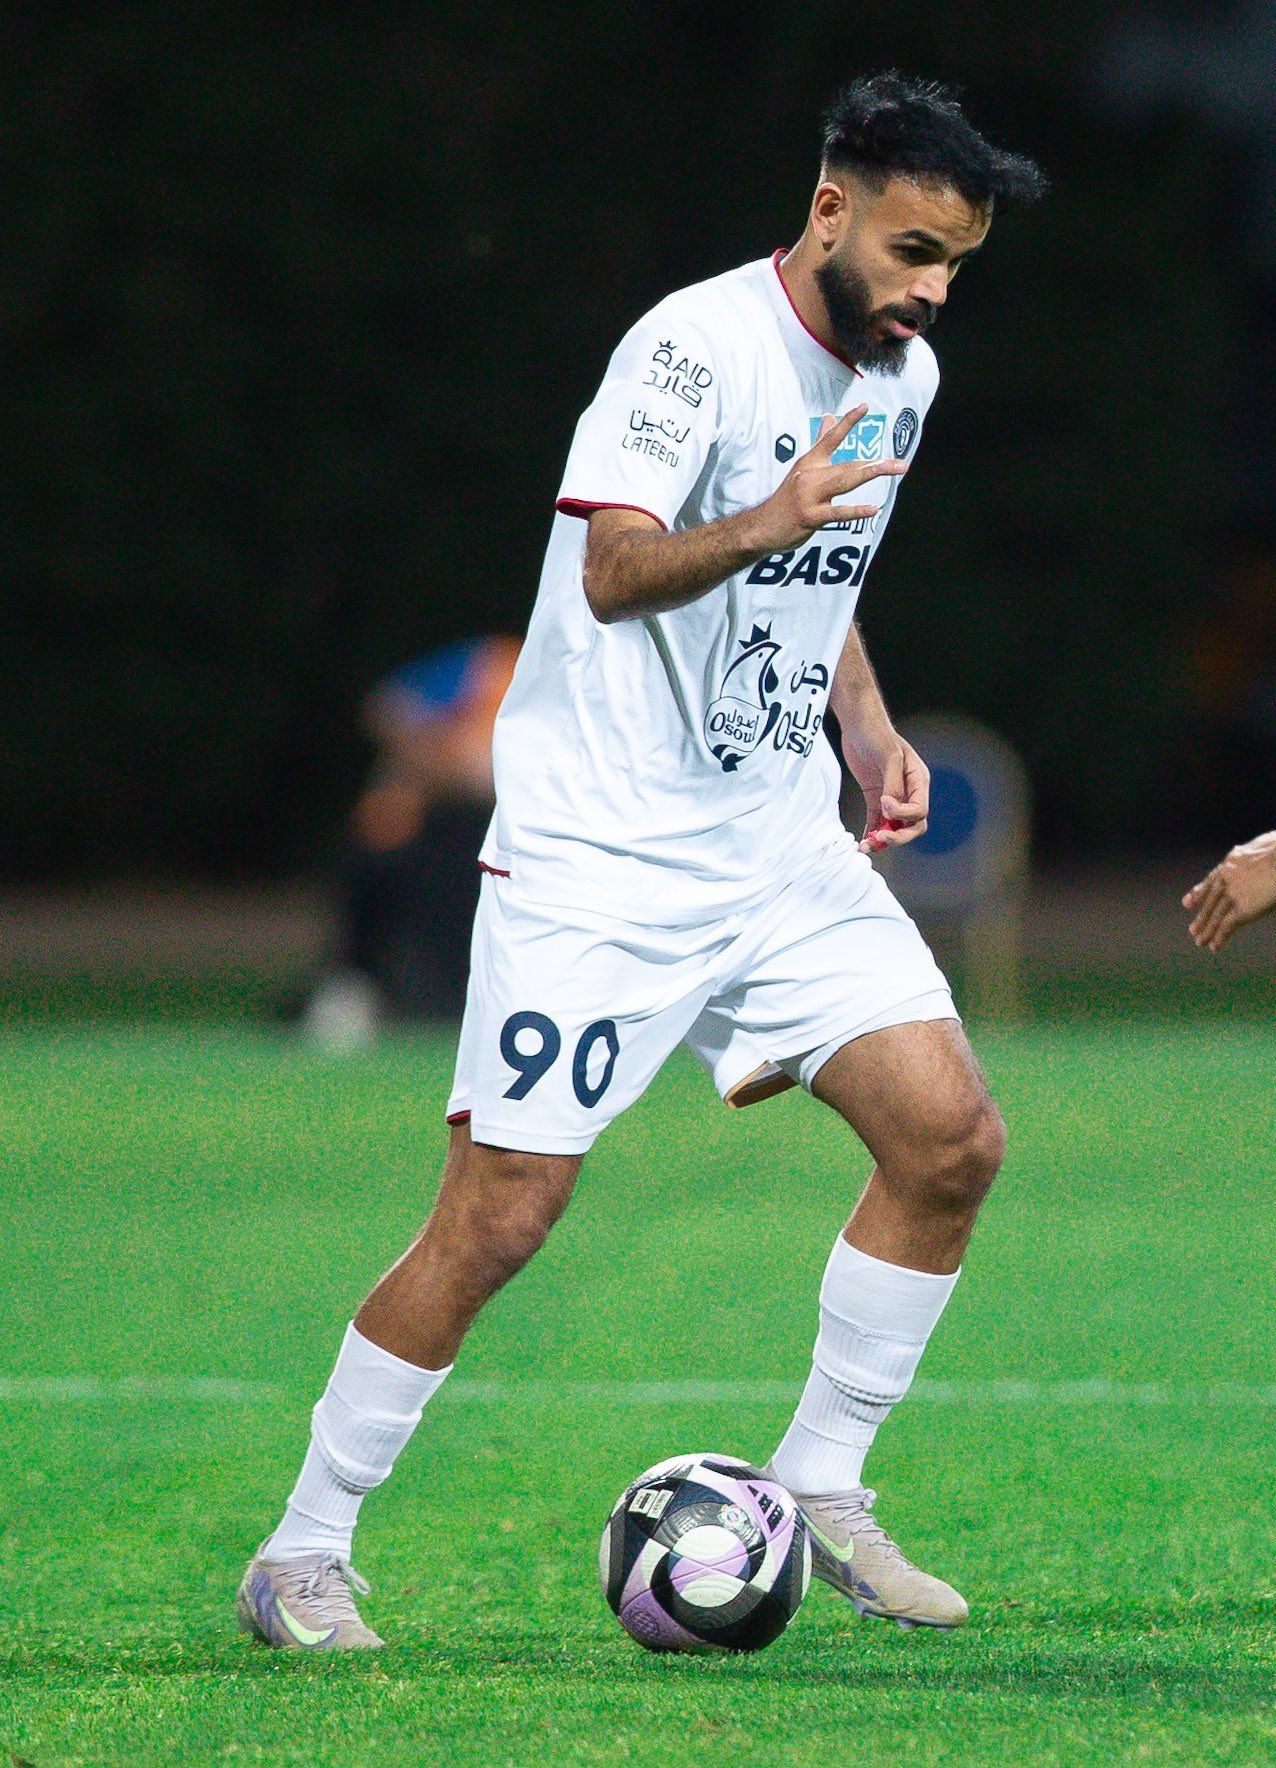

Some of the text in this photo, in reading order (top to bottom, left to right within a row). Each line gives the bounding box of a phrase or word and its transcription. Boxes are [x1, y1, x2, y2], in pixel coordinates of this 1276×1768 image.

[652, 348, 714, 390] QAID
[621, 433, 681, 469] LATEEN
[499, 1010, 621, 1109] 90
